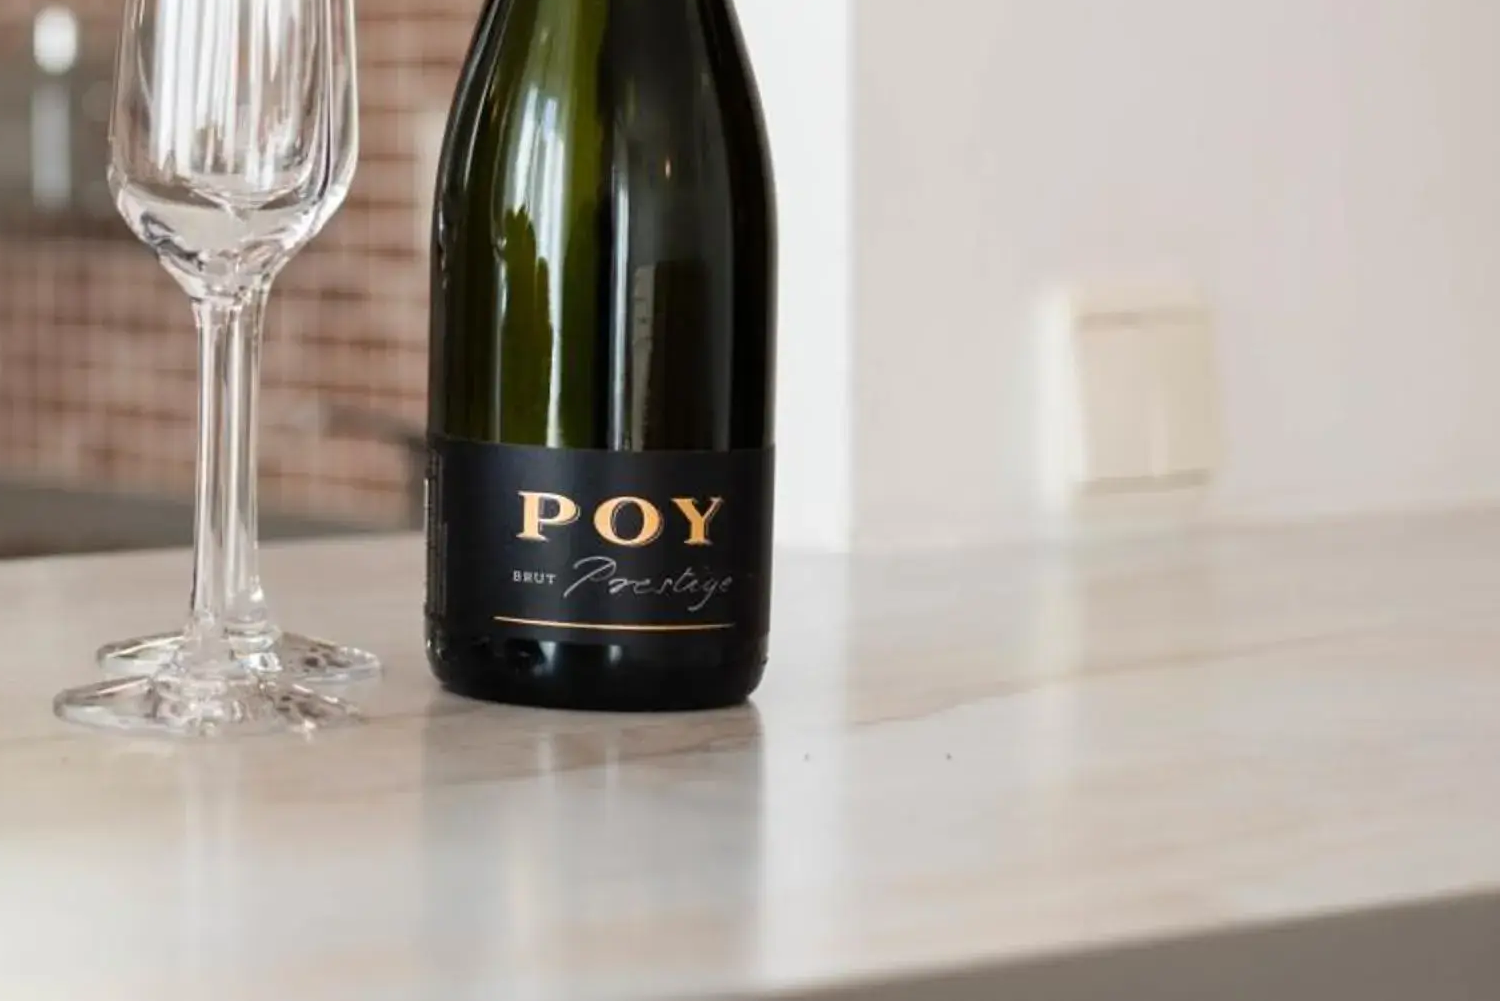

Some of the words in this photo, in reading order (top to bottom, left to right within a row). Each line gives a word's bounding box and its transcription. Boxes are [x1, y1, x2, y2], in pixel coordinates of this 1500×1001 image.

[515, 490, 725, 546] POY
[512, 570, 556, 585] BRUT
[563, 555, 733, 612] Prestige
